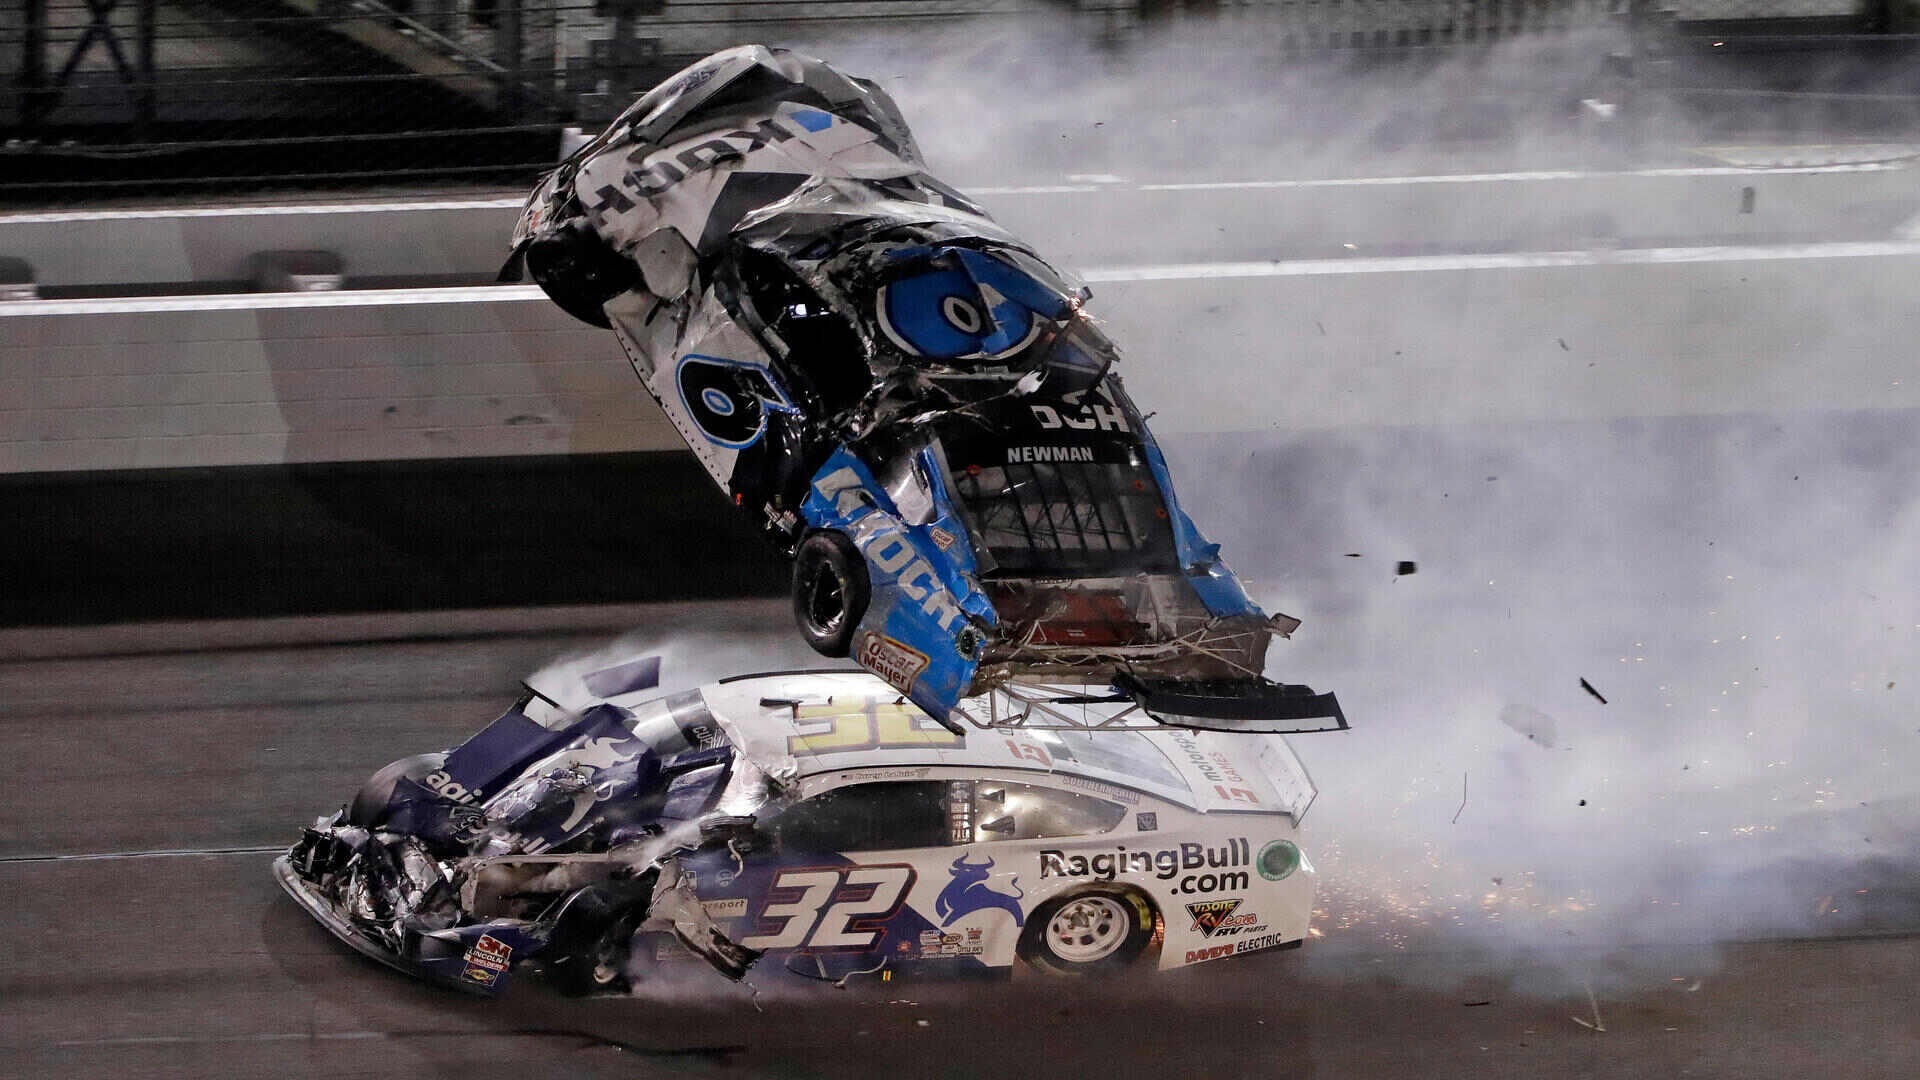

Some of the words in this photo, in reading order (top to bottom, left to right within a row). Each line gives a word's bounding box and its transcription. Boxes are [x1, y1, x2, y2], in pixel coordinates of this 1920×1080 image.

[1007, 446, 1094, 463] NEWMAN
[863, 652, 907, 684] Mayer
[869, 642, 916, 672] Oscar
[1039, 838, 1250, 882] RagingBull
[1171, 871, 1249, 895] .com
[741, 866, 914, 951] 32
[1215, 927, 1243, 937] RV
[1237, 932, 1282, 953] ELECTRIC
[468, 948, 503, 964] LINCOLN
[478, 936, 511, 960] 3M
